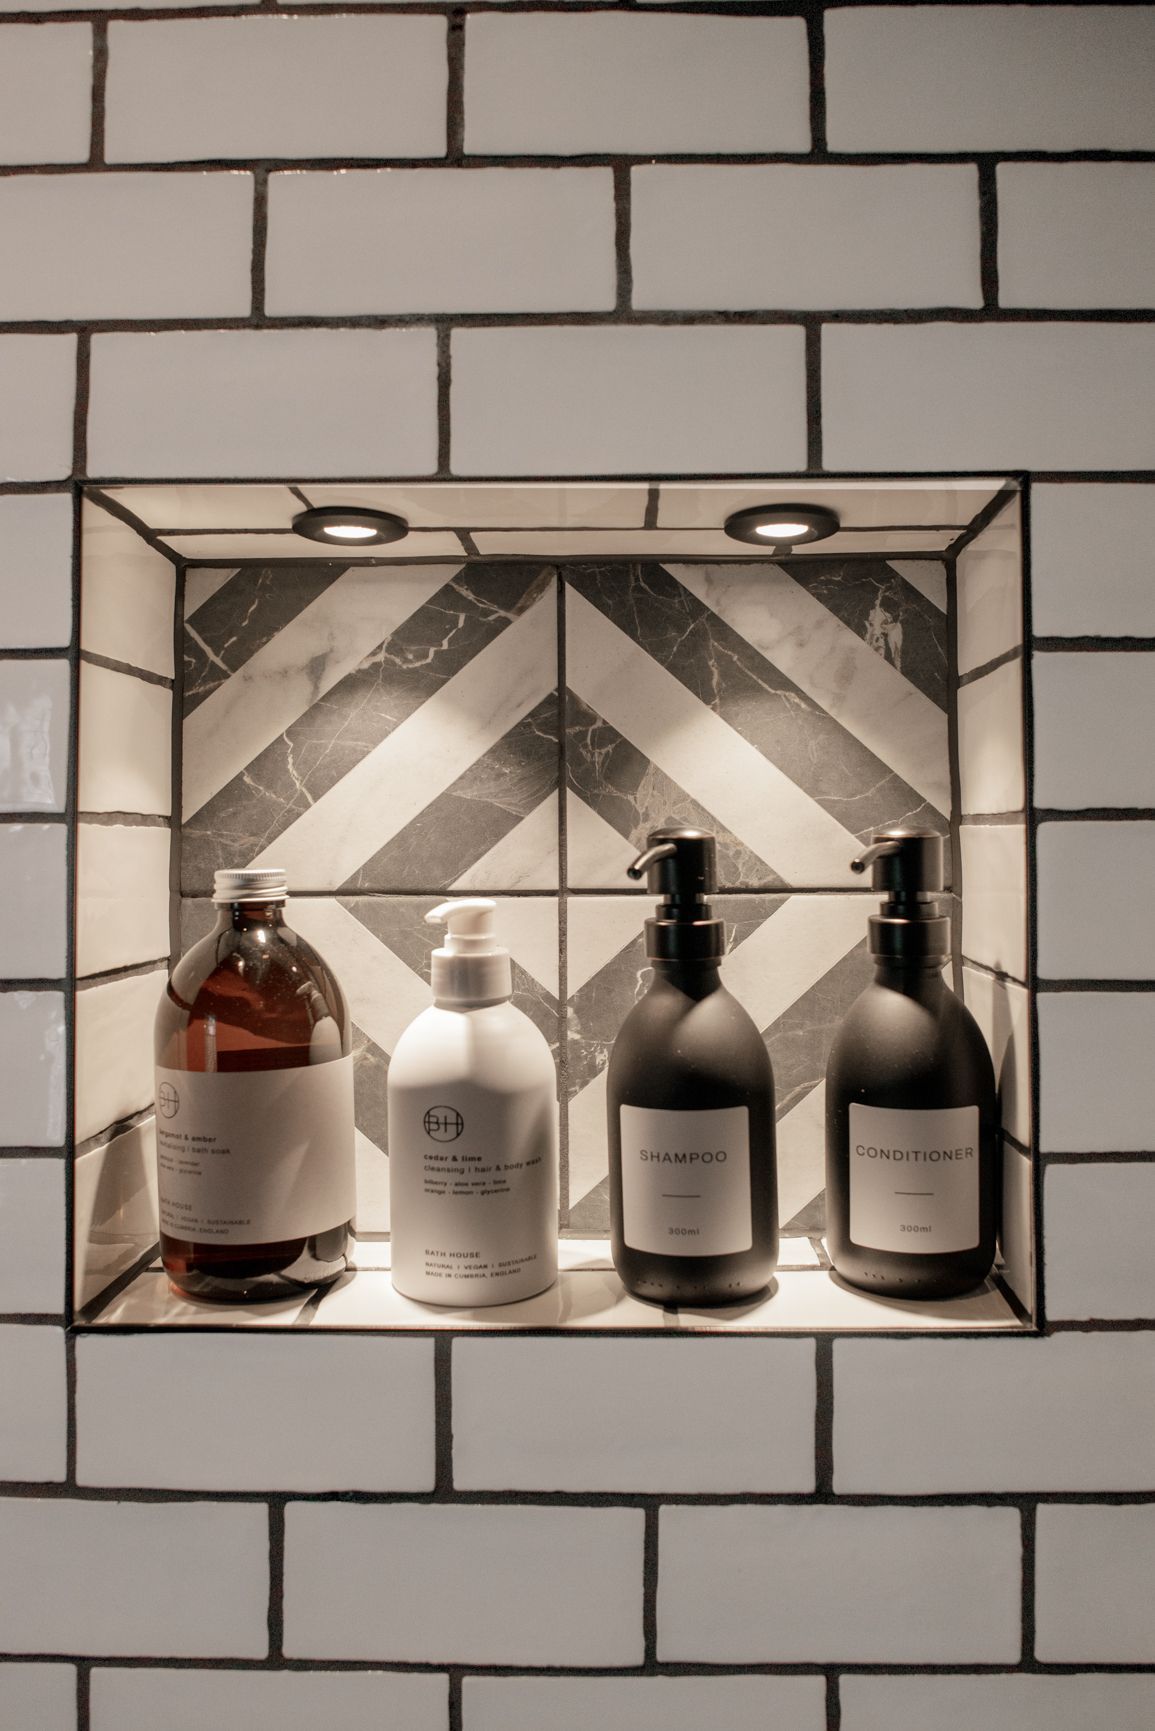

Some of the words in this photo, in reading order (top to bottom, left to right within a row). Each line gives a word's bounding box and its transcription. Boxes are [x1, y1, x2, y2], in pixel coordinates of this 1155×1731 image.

[423, 1154, 449, 1162] cedar
[639, 1149, 728, 1164] SHAMPOO
[855, 1144, 975, 1162] CONDITIONER
[423, 1164, 465, 1175] cleansing
[474, 1165, 493, 1173] hair
[495, 1164, 502, 1172] &
[504, 1162, 524, 1172] body
[668, 1227, 700, 1236] 300ml
[899, 1224, 932, 1234] 300ml
[424, 1249, 446, 1258] BATH
[448, 1251, 481, 1259] HOUSE
[425, 1261, 453, 1270] NATURAL
[497, 1254, 538, 1268] SUSTAINABLE
[425, 1270, 443, 1278] MADE
[490, 1267, 522, 1278] ENGLAND
